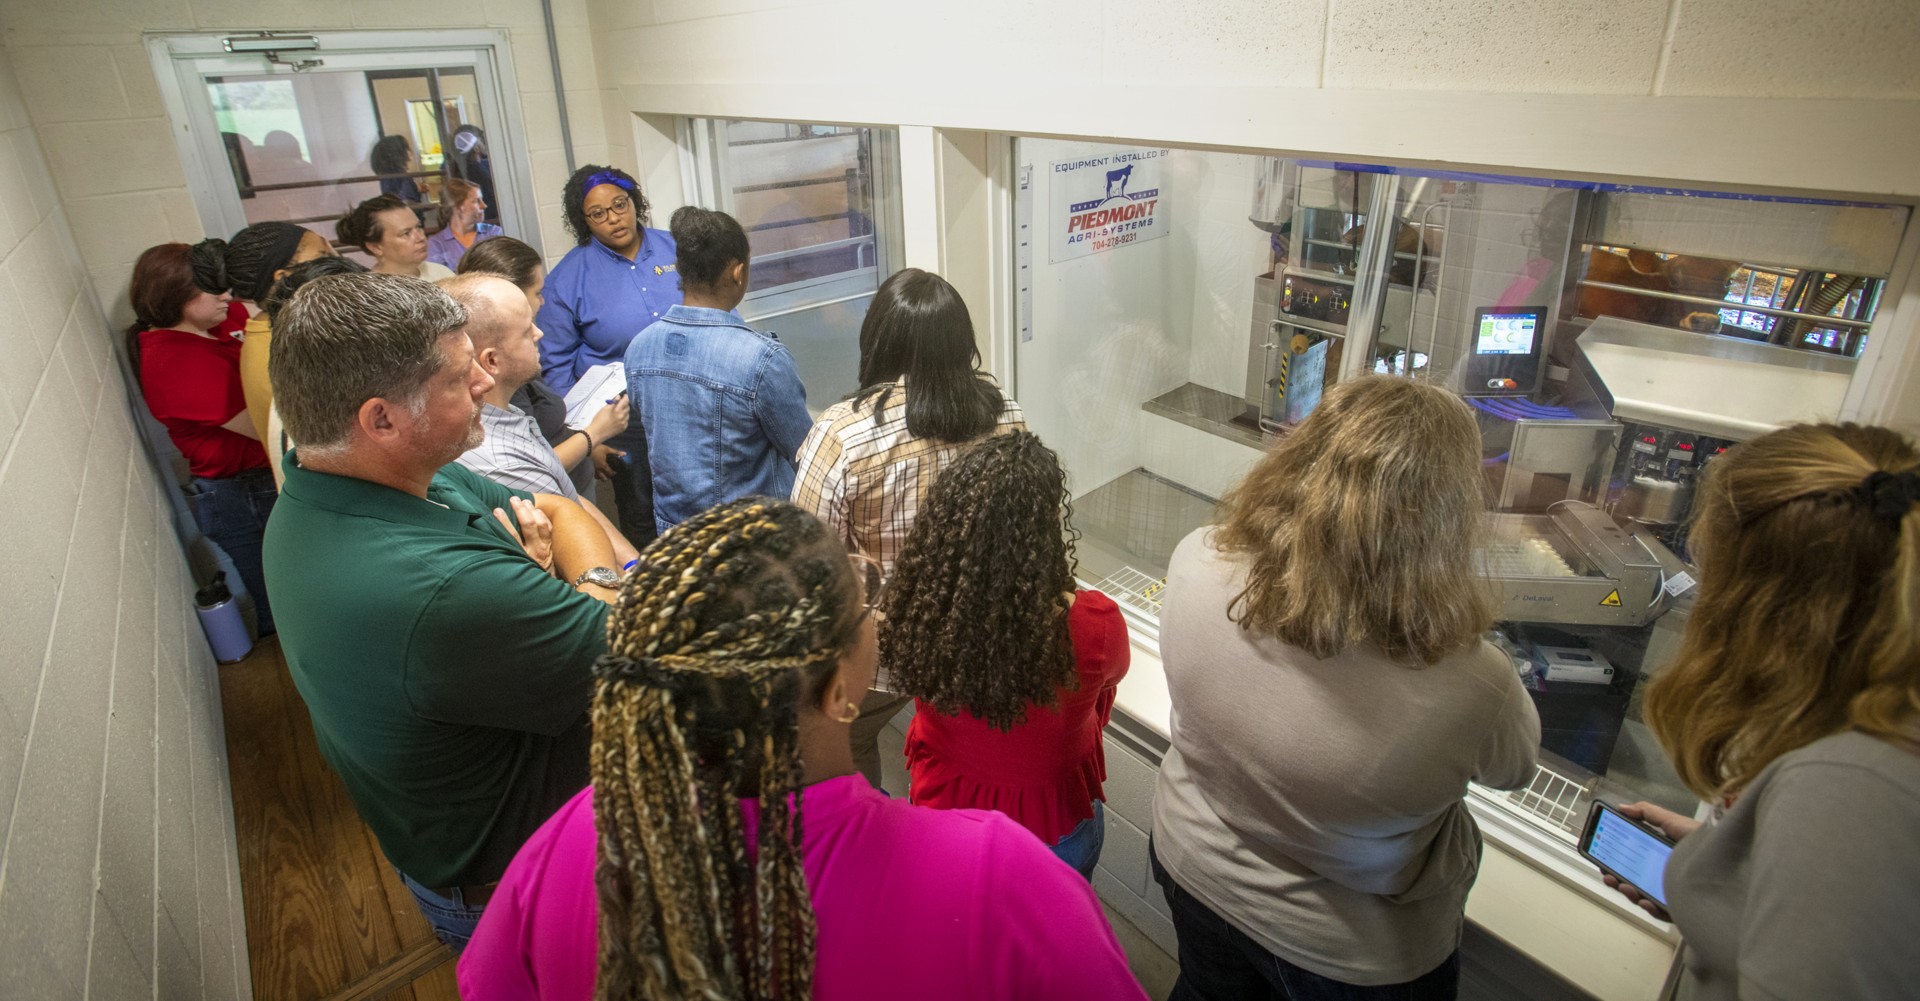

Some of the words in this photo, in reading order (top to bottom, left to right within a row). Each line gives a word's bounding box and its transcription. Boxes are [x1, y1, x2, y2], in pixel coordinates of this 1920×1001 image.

[1055, 157, 1109, 172] EQUIPMENT
[1112, 150, 1158, 164] INSTALLED
[1160, 149, 1170, 157] BY
[1068, 199, 1158, 233] PIEDMONT
[1067, 218, 1153, 244] AGRI-SYSTEMS
[1092, 232, 1137, 250] 704-278-9231
